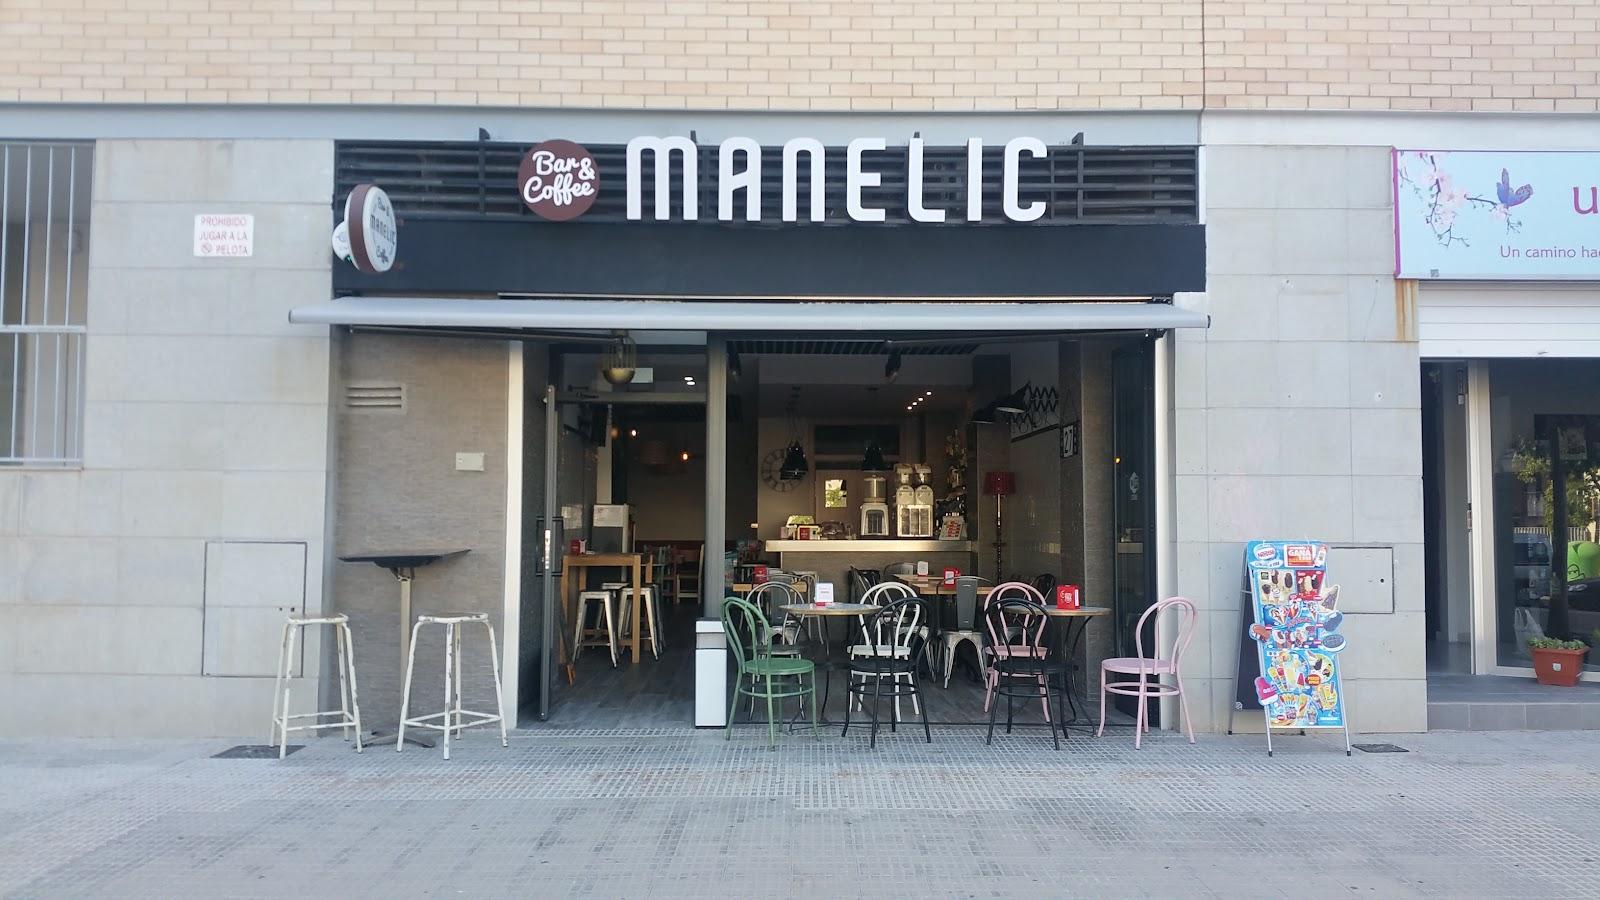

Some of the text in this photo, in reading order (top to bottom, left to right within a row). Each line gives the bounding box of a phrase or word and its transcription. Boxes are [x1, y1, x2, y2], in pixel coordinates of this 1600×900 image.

[532, 150, 580, 176] Bar
[626, 136, 1048, 223] MANELIC
[523, 172, 596, 207] Coffee
[200, 215, 247, 226] PROHIBIDO
[199, 231, 248, 241] JUGAR A LA
[215, 244, 248, 255] PELOTA
[1500, 245, 1520, 258] Un
[1525, 245, 1577, 258] camino
